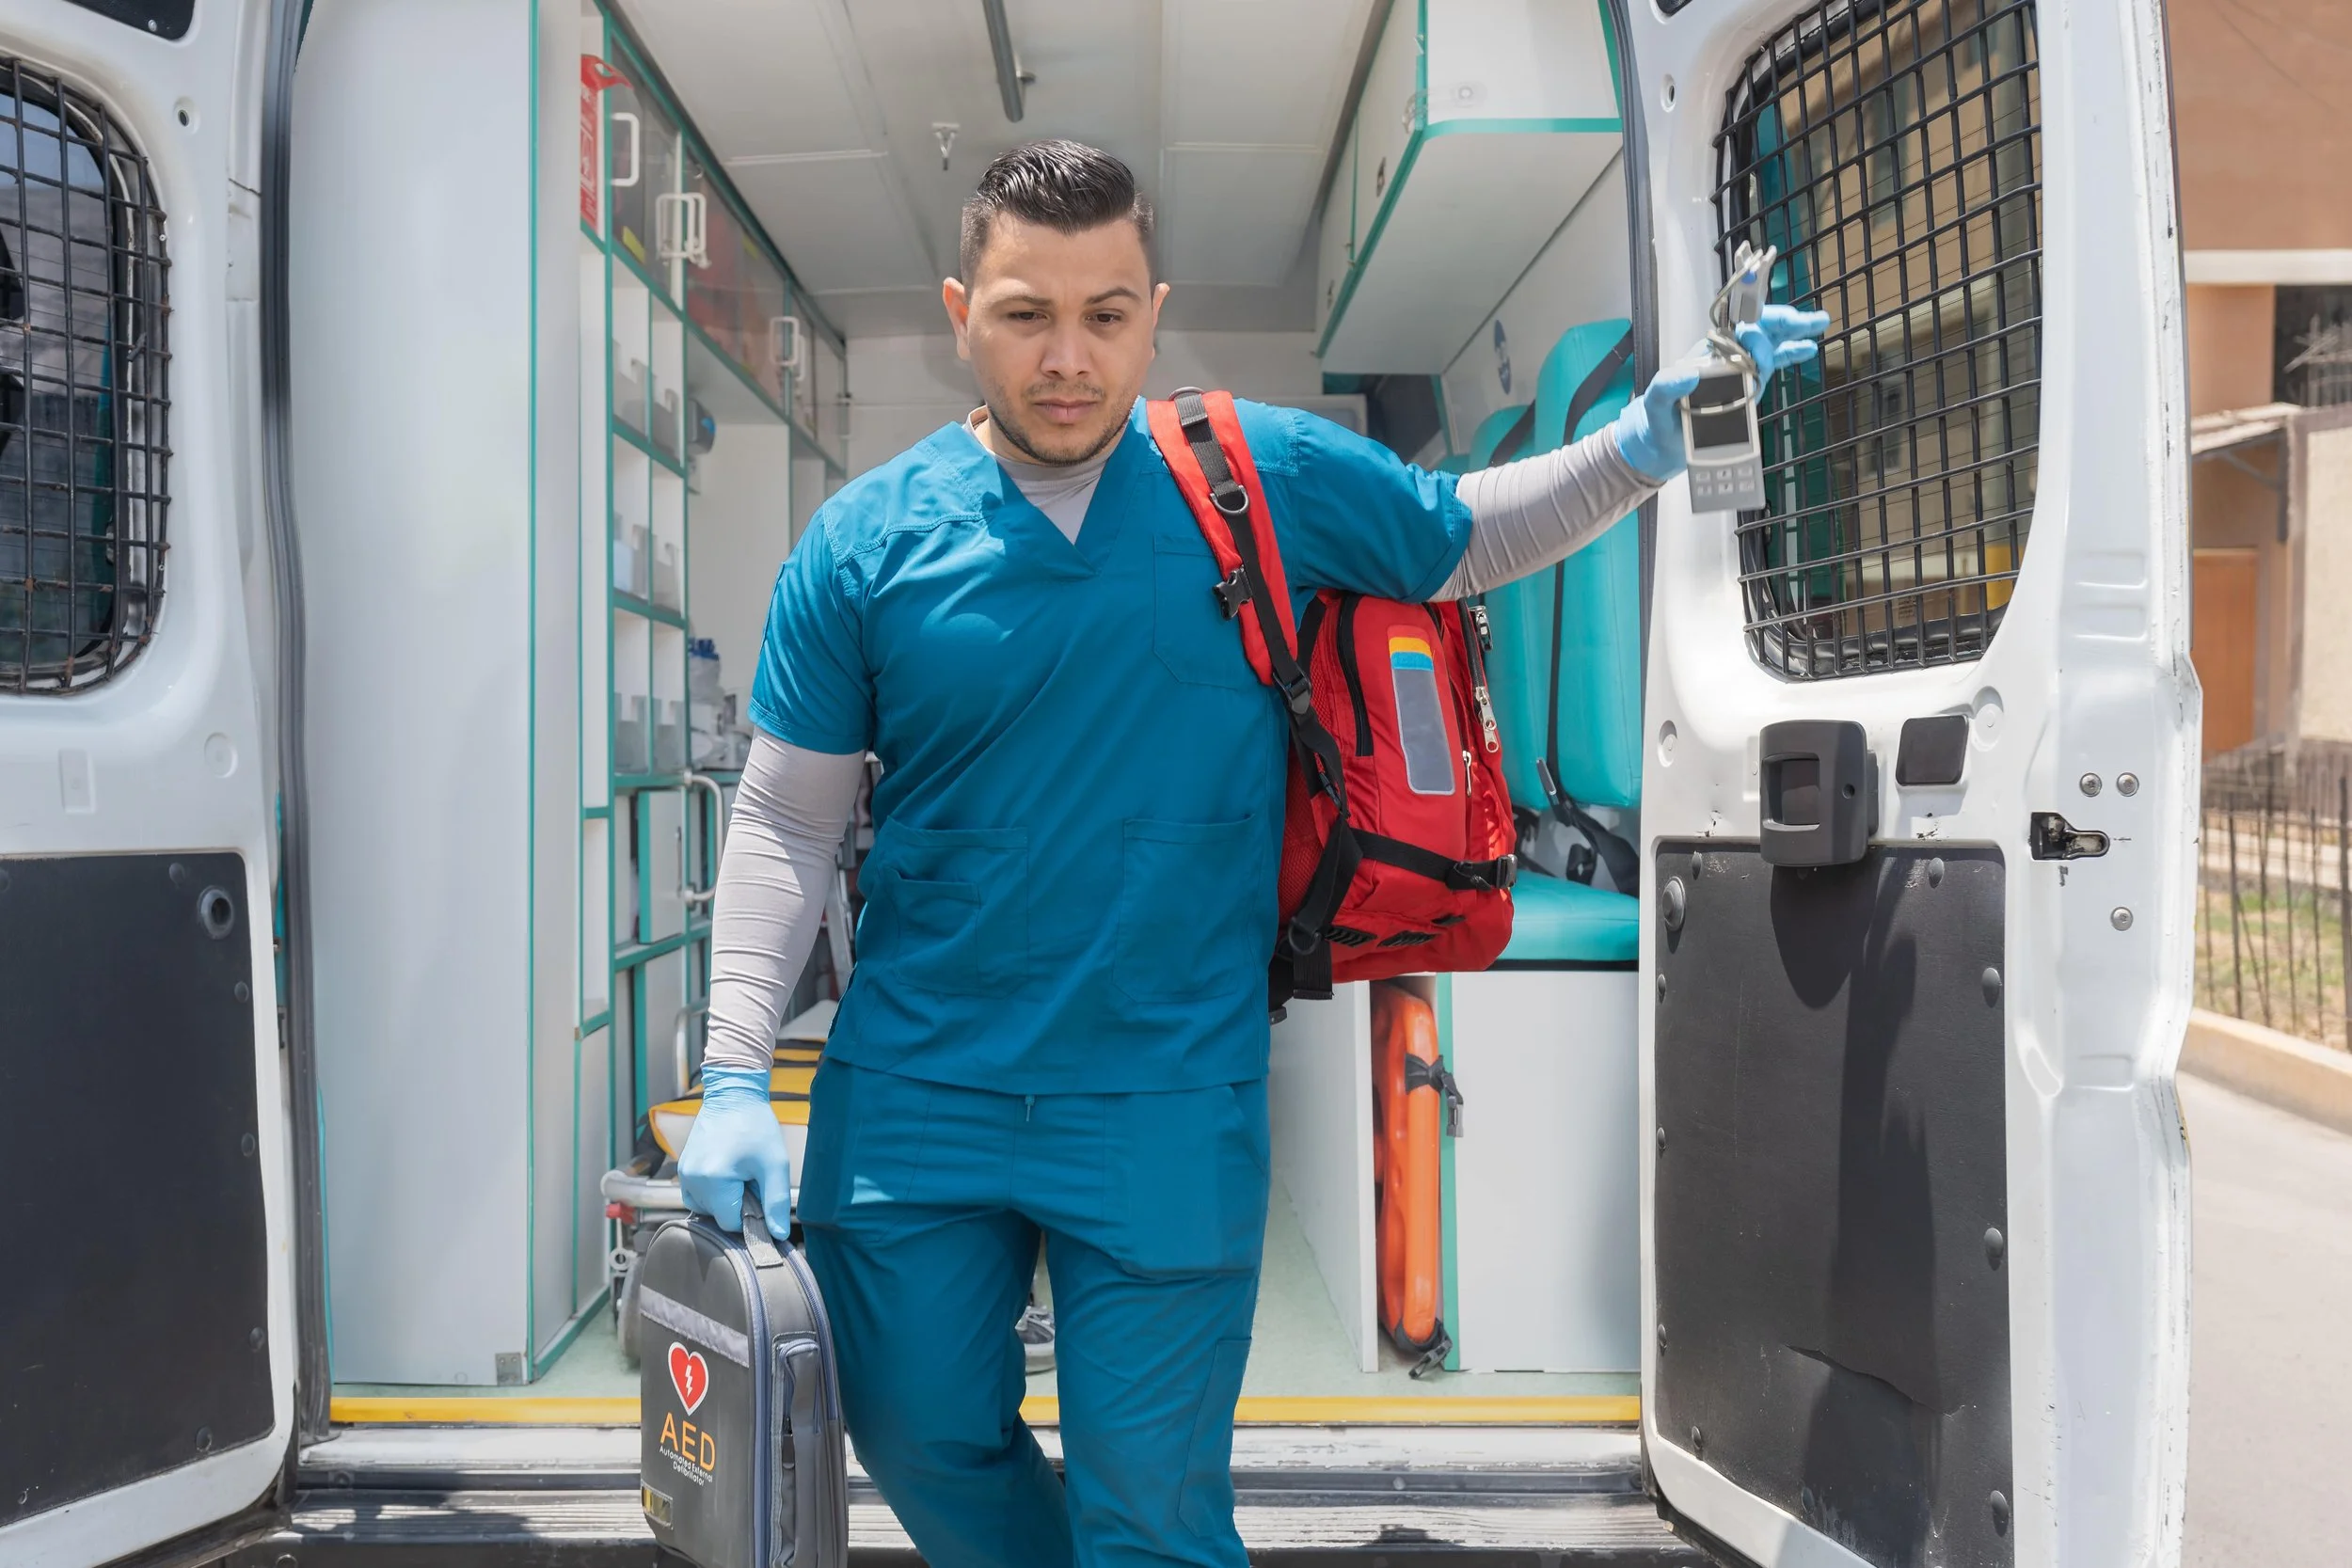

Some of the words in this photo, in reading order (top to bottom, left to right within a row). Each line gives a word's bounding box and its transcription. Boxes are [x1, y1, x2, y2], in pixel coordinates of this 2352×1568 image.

[660, 1412, 715, 1471] AED
[660, 1445, 691, 1469] Automated
[691, 1463, 713, 1482] External
[673, 1461, 705, 1486] Defibrillator
